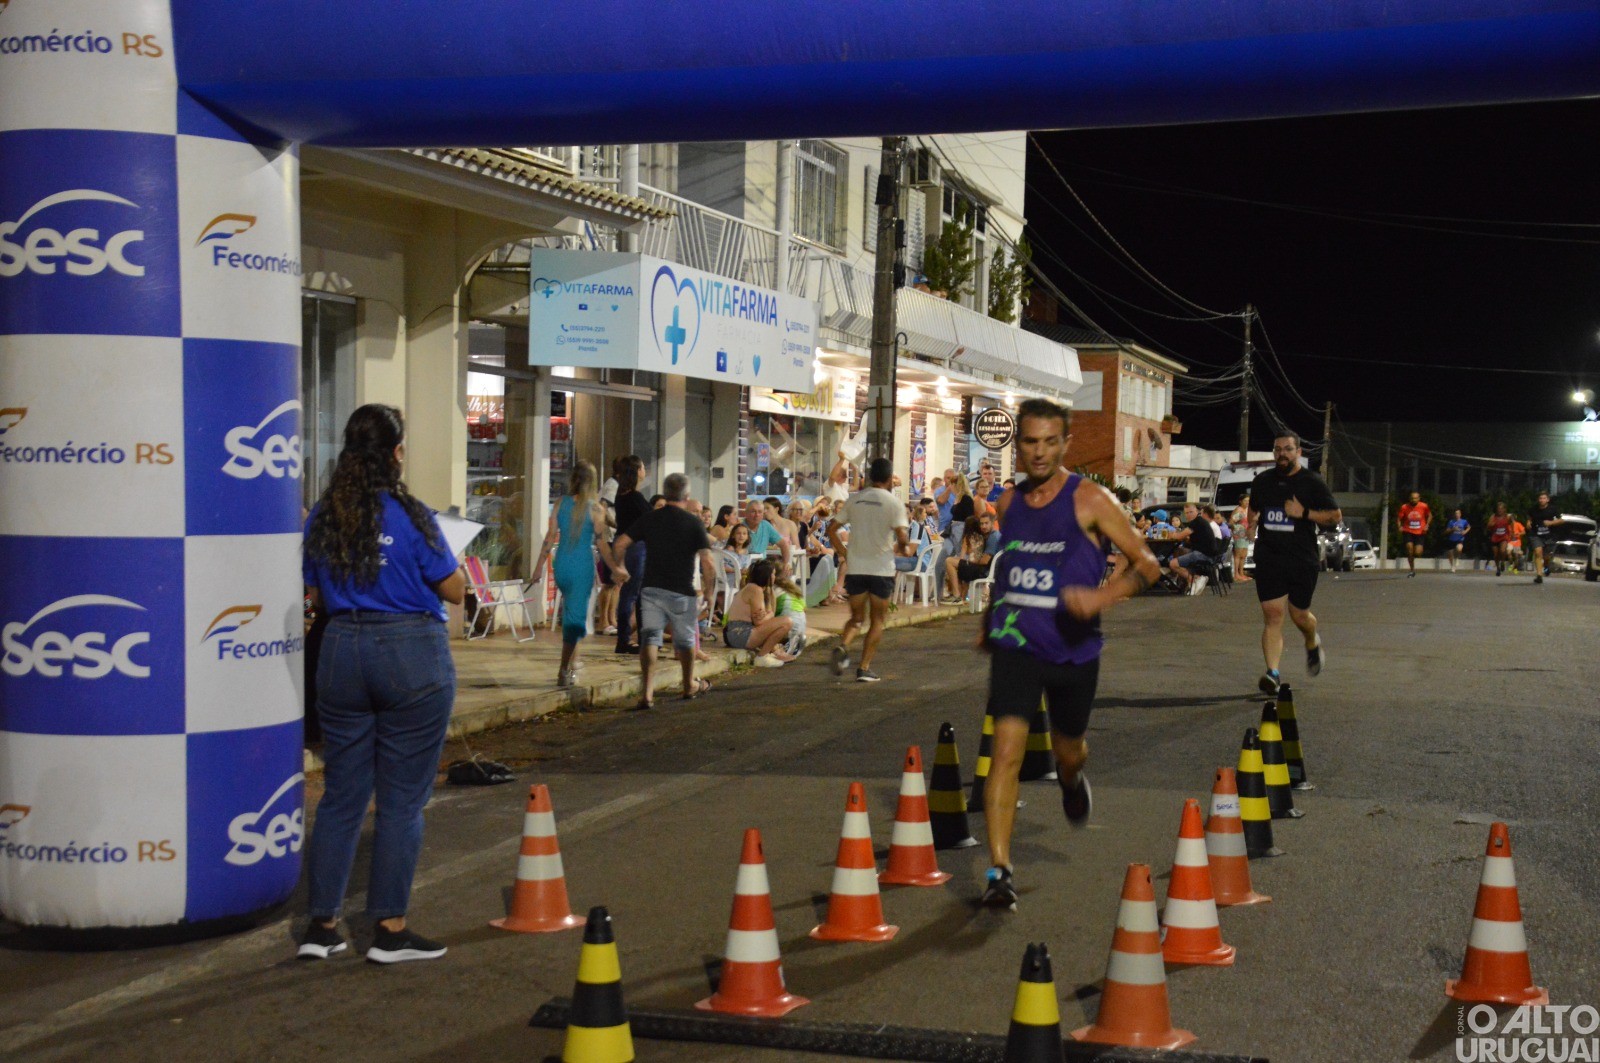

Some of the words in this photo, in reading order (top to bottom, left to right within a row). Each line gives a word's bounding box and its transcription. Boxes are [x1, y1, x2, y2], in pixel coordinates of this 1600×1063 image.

[122, 33, 164, 58] RS
[563, 283, 634, 296] VITAFARMA
[699, 276, 778, 327] VITAFARMA
[984, 414, 1007, 423] HOTEL
[0, 442, 125, 464] ecomércio
[135, 443, 174, 465] RS
[1267, 511, 1290, 523] 08
[1009, 566, 1054, 592] 063
[138, 840, 177, 863] RS
